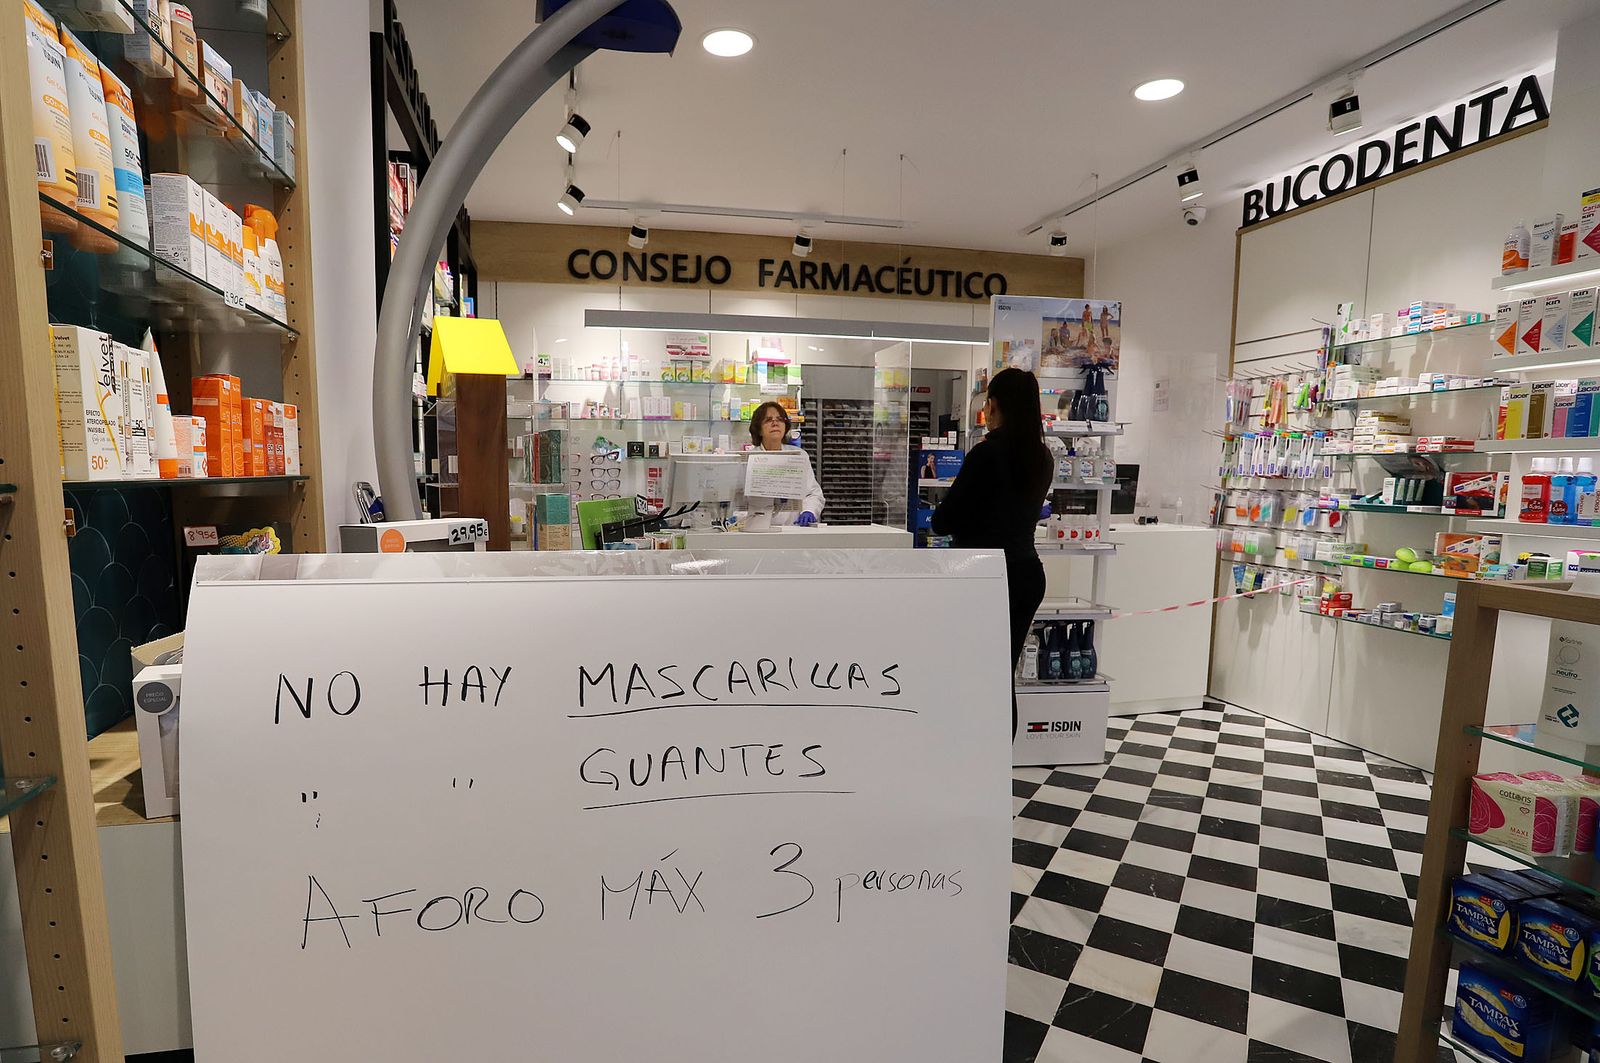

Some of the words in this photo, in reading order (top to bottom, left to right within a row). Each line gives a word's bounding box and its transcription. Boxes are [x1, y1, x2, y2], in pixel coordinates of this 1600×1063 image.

[1242, 74, 1550, 227] BUCODENTA
[567, 248, 732, 285] CONSEJO
[757, 257, 1008, 299] FARMACÉUTICO
[1532, 382, 1555, 390] Lacer
[91, 455, 109, 471] 50+
[451, 523, 488, 543] 29,95€
[274, 671, 362, 725] NO
[419, 665, 512, 708] HAY
[578, 656, 901, 706] MASCARILLAS
[1050, 720, 1081, 732] ISDIN
[579, 743, 826, 791] GUANTES
[1510, 827, 1529, 837] MAXI
[301, 874, 545, 950] AFORO
[600, 848, 706, 921] MÁX
[756, 842, 815, 919] 3
[832, 869, 963, 923] personas
[1456, 903, 1496, 928] TAMPAX
[1523, 929, 1569, 958] TAMPAX
[1468, 996, 1520, 1031] TAMPAX
